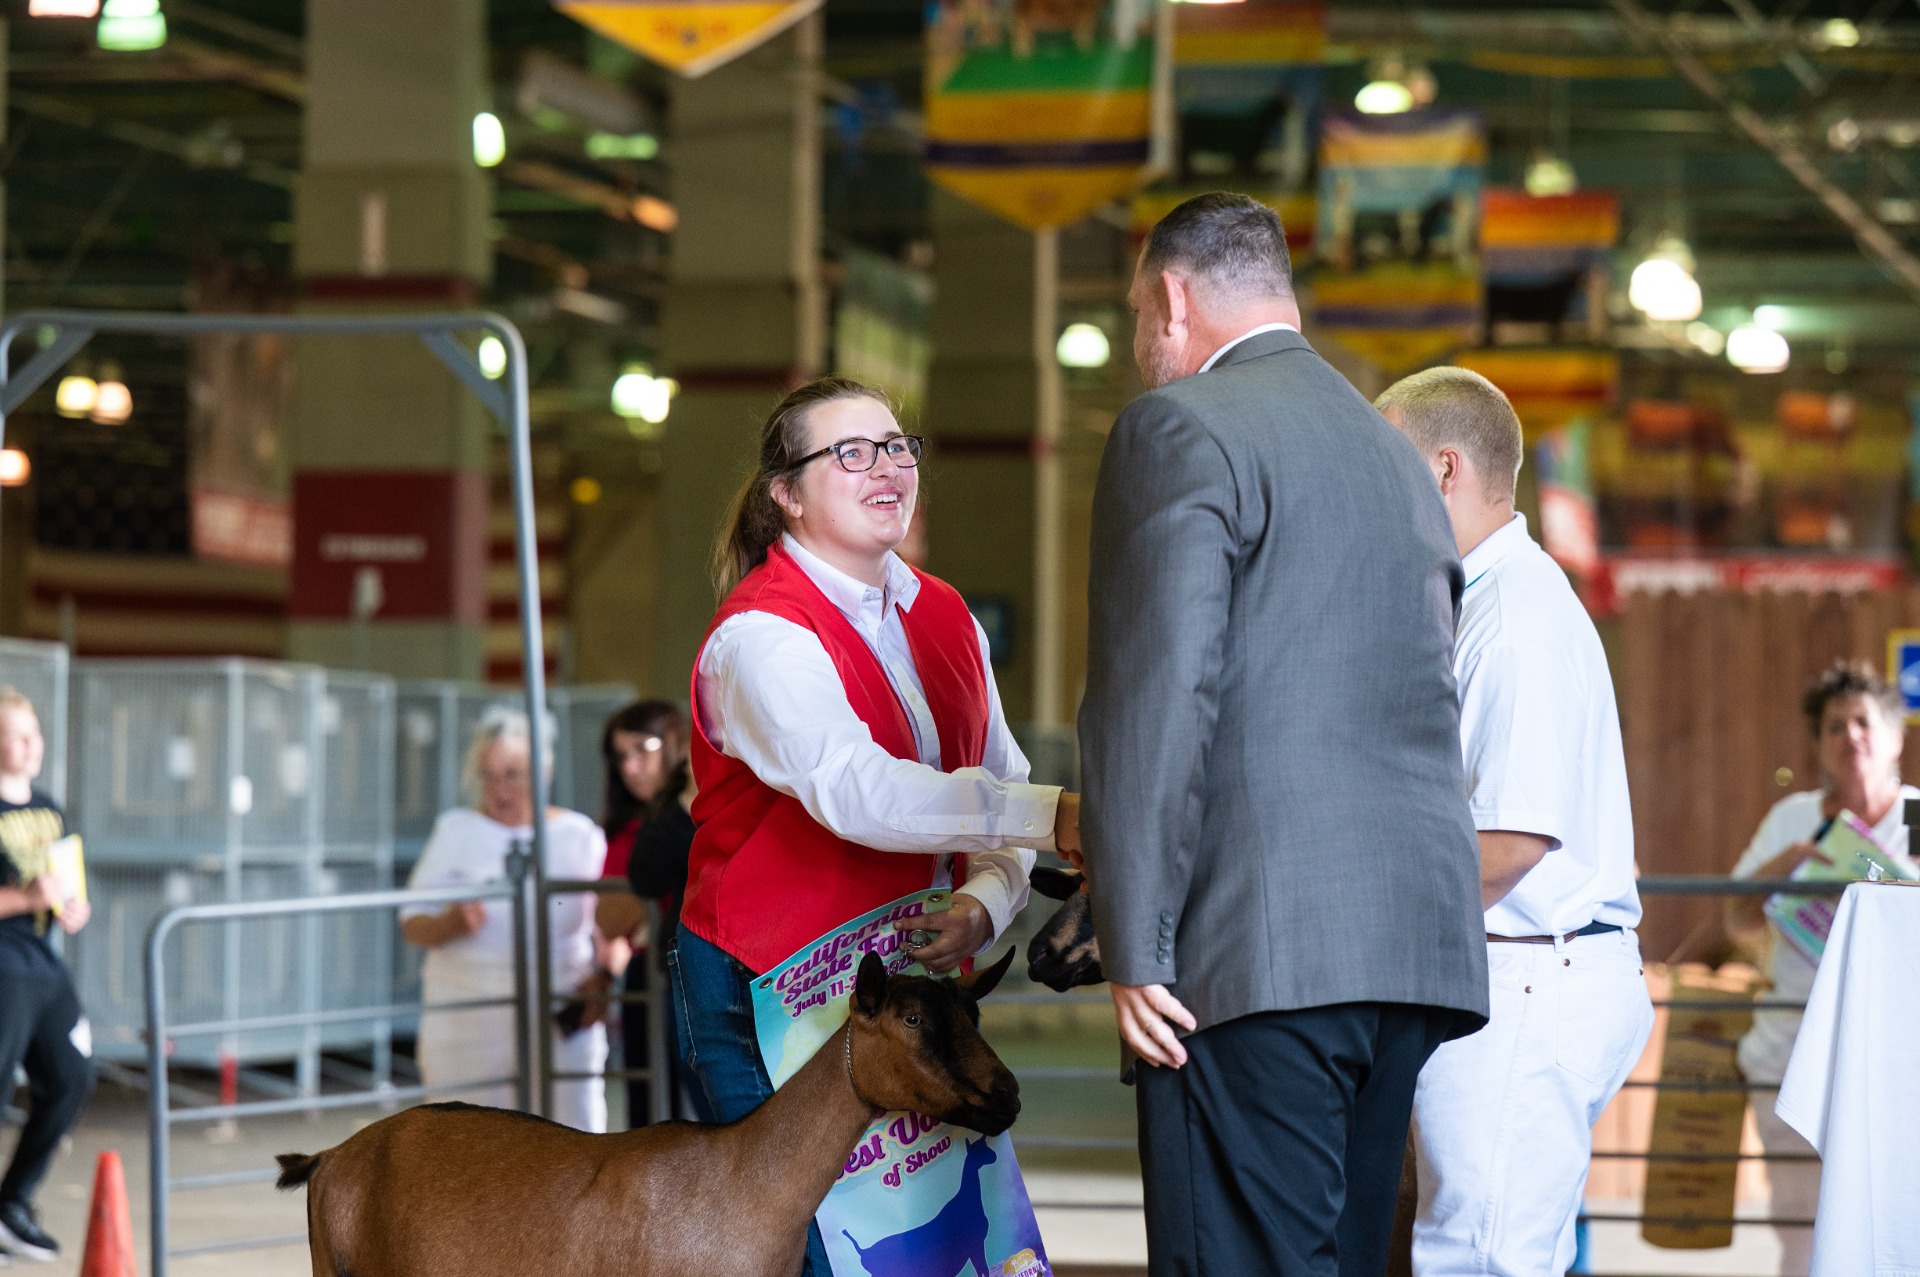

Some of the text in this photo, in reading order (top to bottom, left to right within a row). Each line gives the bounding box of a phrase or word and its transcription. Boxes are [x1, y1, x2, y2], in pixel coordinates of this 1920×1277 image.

[775, 901, 924, 992] California
[783, 953, 852, 1005] State
[792, 991, 827, 1018] July
[836, 1134, 886, 1179] est
[882, 1136, 951, 1187] of Show
